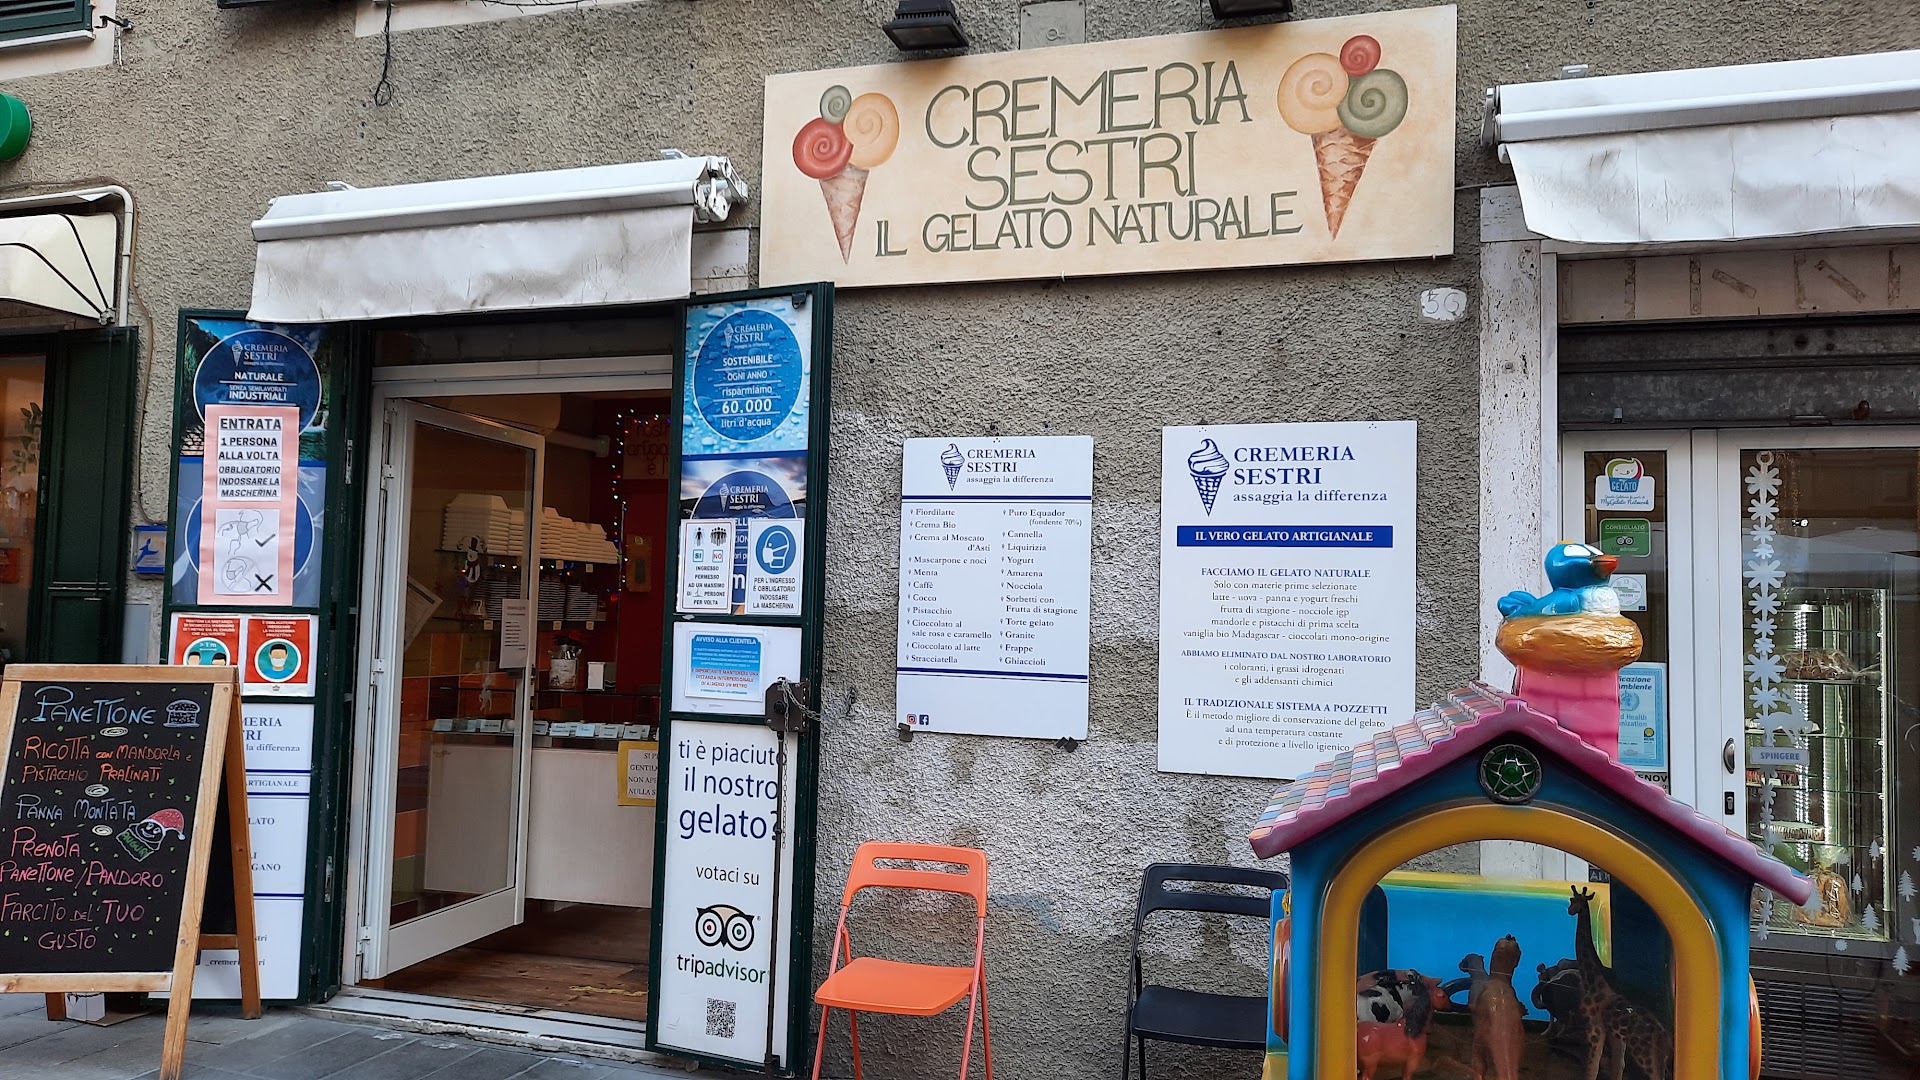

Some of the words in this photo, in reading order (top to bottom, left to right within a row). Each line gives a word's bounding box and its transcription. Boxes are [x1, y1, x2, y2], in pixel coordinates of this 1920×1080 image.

[925, 60, 1253, 148] CREMERIA
[966, 132, 1198, 210] SESTRI
[875, 220, 908, 257] IL
[922, 209, 1072, 252] GELATO
[1086, 192, 1302, 247] NATURALE
[735, 323, 773, 333] CREMERIA
[734, 333, 763, 343] SESTRI
[244, 344, 288, 352] CREMERIA
[244, 352, 276, 360] SESTRI
[723, 355, 773, 366] SOSTENIBILE
[235, 372, 283, 381] NATURALE
[728, 372, 745, 380] OGNI
[747, 371, 767, 379] ANNO
[230, 391, 286, 400] INDUSTRIALI
[722, 386, 772, 397] risparmiamo
[722, 399, 772, 414] 60.000
[220, 418, 281, 430] ENTRATA
[722, 418, 736, 428] litri
[739, 418, 771, 428] d'acqua
[221, 438, 226, 446] 1
[230, 438, 277, 446] PERSONA
[219, 452, 243, 460] ALLA
[246, 452, 278, 460] VOLTA
[967, 449, 1036, 459] CREMERIA
[1234, 446, 1355, 463] CREMERIA
[967, 462, 1017, 473] SESTRI
[966, 476, 1001, 485] assaggia
[1234, 468, 1322, 485] SESTRI
[730, 486, 769, 494] CREMERIA
[1612, 481, 1636, 491] GELATO
[730, 494, 758, 503] SESTRI
[1233, 490, 1293, 505] assaggia
[1298, 490, 1310, 501] la
[1314, 490, 1388, 501] differenza
[1030, 509, 1066, 518] Equador
[1195, 532, 1207, 541] IL
[1208, 531, 1240, 541] VERO
[1242, 531, 1290, 541] GELATO
[1292, 531, 1374, 542] ARTIGIANALE
[1008, 543, 1047, 553] Liquirizia
[914, 556, 961, 566] Mascarpone
[1007, 556, 1034, 566] Yogurt
[1202, 568, 1255, 576] FACCIAMO
[1258, 568, 1267, 576] IL
[1270, 569, 1312, 577] GELATO
[1315, 569, 1371, 578] NATURALE
[1007, 582, 1043, 590] Nocciola
[1214, 580, 1232, 589] Solo
[1251, 582, 1282, 590] materie
[1284, 582, 1309, 592] prime
[1312, 581, 1357, 591] selezionate
[913, 594, 937, 602] Cocco
[1006, 595, 1037, 603] Sorbetti
[913, 606, 953, 615] Pistacchio
[1044, 607, 1078, 616] stagione
[1005, 618, 1027, 626] Torte
[1029, 619, 1054, 628] gelato
[1005, 631, 1035, 639] Granite
[911, 655, 958, 664] Stracciatella
[1004, 657, 1046, 666] Ghiaccioli
[1328, 654, 1391, 663] LABORATORIO
[1184, 698, 1194, 706] IL
[1196, 698, 1274, 710] TRADIZIONALE
[1276, 702, 1321, 712] SISTEMA
[1334, 704, 1387, 714] POZZETTI
[23, 736, 90, 760] RICOTTA
[116, 745, 180, 761] MANDORLA
[678, 740, 690, 759] ti
[696, 740, 706, 760] è
[712, 742, 787, 766] piaciuto
[1760, 752, 1800, 761] SPINGERE
[684, 767, 695, 792] il
[704, 773, 778, 800] nostro
[15, 794, 63, 821] PANNA
[73, 798, 136, 820] MONTATA
[696, 866, 739, 883] votaci
[744, 871, 759, 886] su
[0, 893, 66, 922] FARCITO
[102, 900, 145, 924] TUO
[38, 928, 96, 950] GUSTO
[677, 954, 766, 984] tripadvisor
